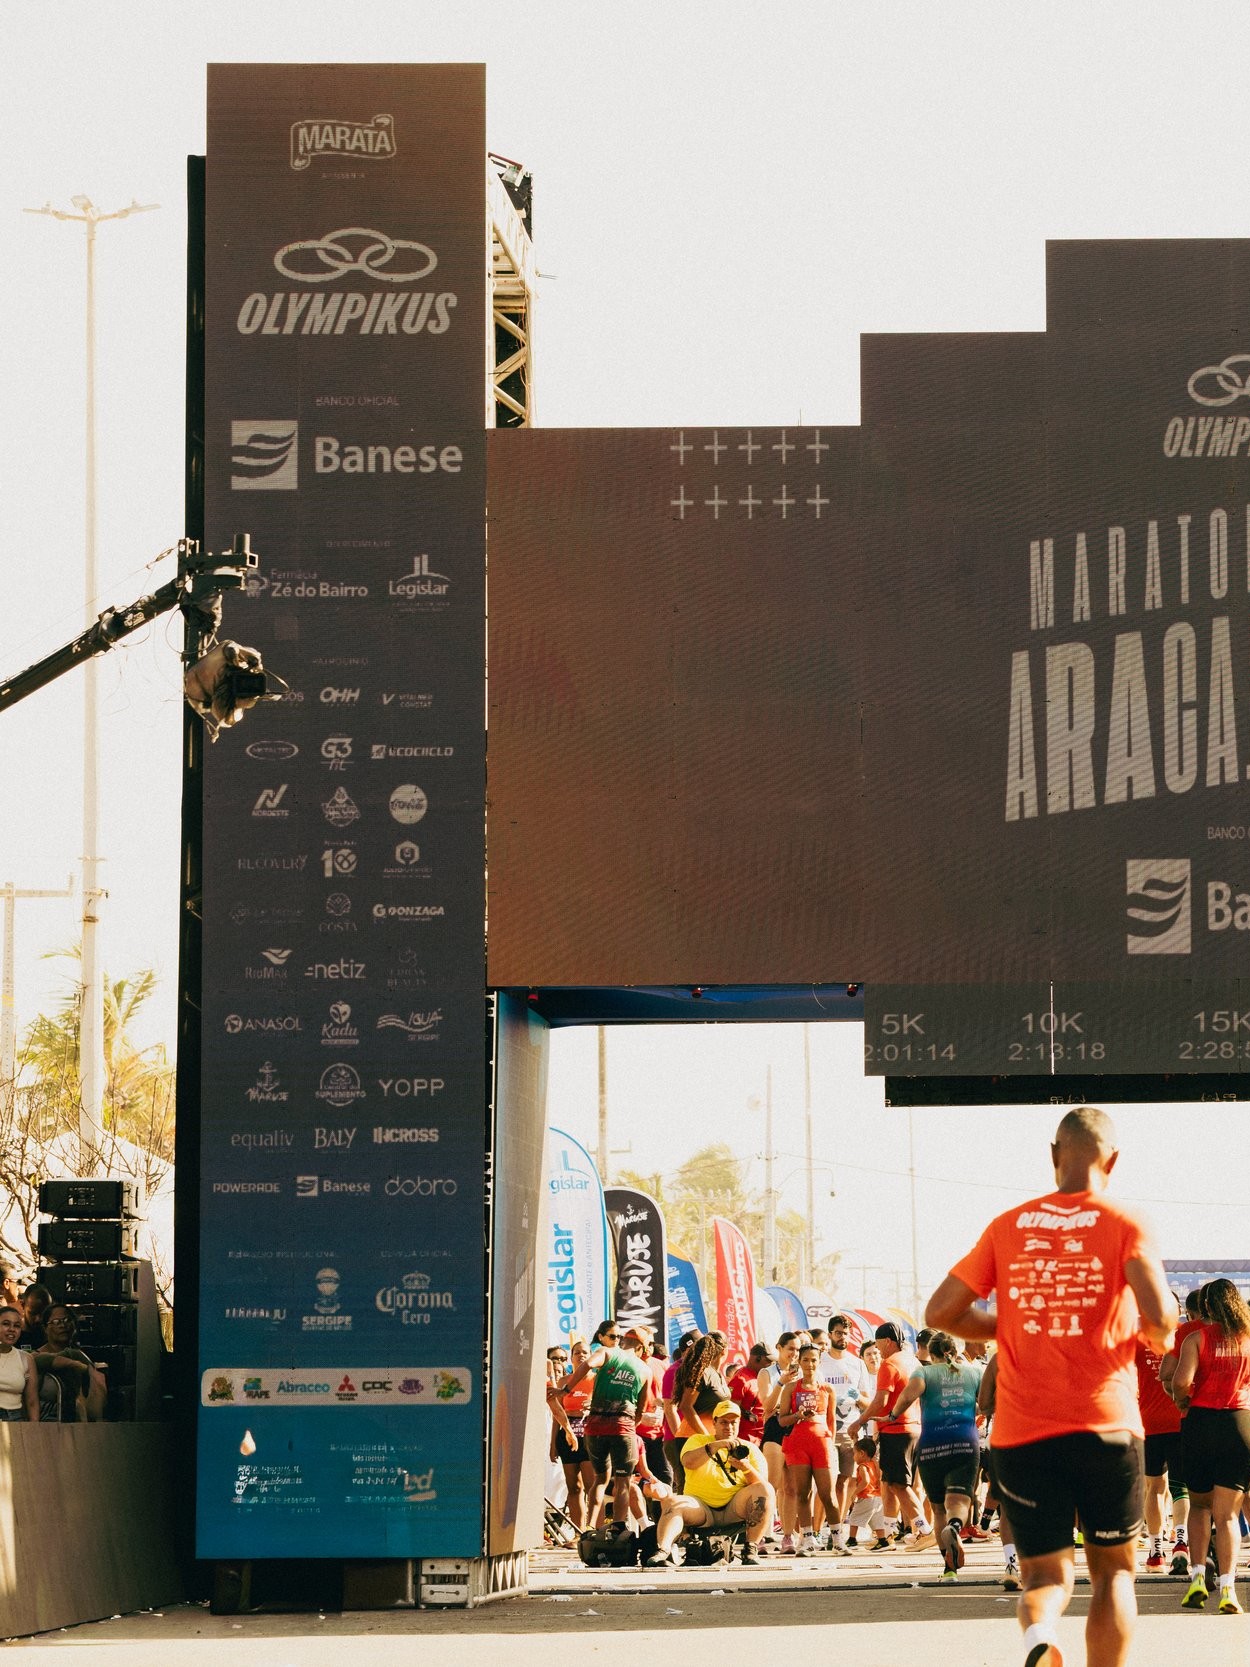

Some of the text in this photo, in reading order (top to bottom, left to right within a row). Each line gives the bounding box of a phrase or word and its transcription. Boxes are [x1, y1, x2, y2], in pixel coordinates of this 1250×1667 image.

[237, 293, 457, 335] OLYMPIKUS
[316, 396, 399, 407] BANCO OFICIAL
[315, 437, 463, 473] Banese
[271, 581, 369, 597] Zé do Bairro
[389, 580, 449, 599] Legislar
[1207, 826, 1245, 840] BANCO
[388, 906, 445, 916] GONZAGA
[244, 1017, 303, 1031] ANASOL
[321, 1023, 358, 1038] Kadu
[881, 1013, 926, 1035] 5K
[1022, 1012, 1084, 1034] 10K
[864, 1043, 957, 1061] 2:01:14
[378, 1078, 445, 1097] YOPP
[231, 1129, 294, 1150] equaliv
[314, 1127, 357, 1149] BALY
[213, 1182, 280, 1193] POWERADE
[322, 1180, 371, 1193] Banese
[384, 1175, 457, 1196] dobro
[549, 1175, 590, 1194] gislar
[375, 1287, 454, 1315] Corona
[302, 1315, 352, 1325] SERGIPE
[401, 1310, 431, 1325] Cero
[615, 1370, 636, 1381] Alfa
